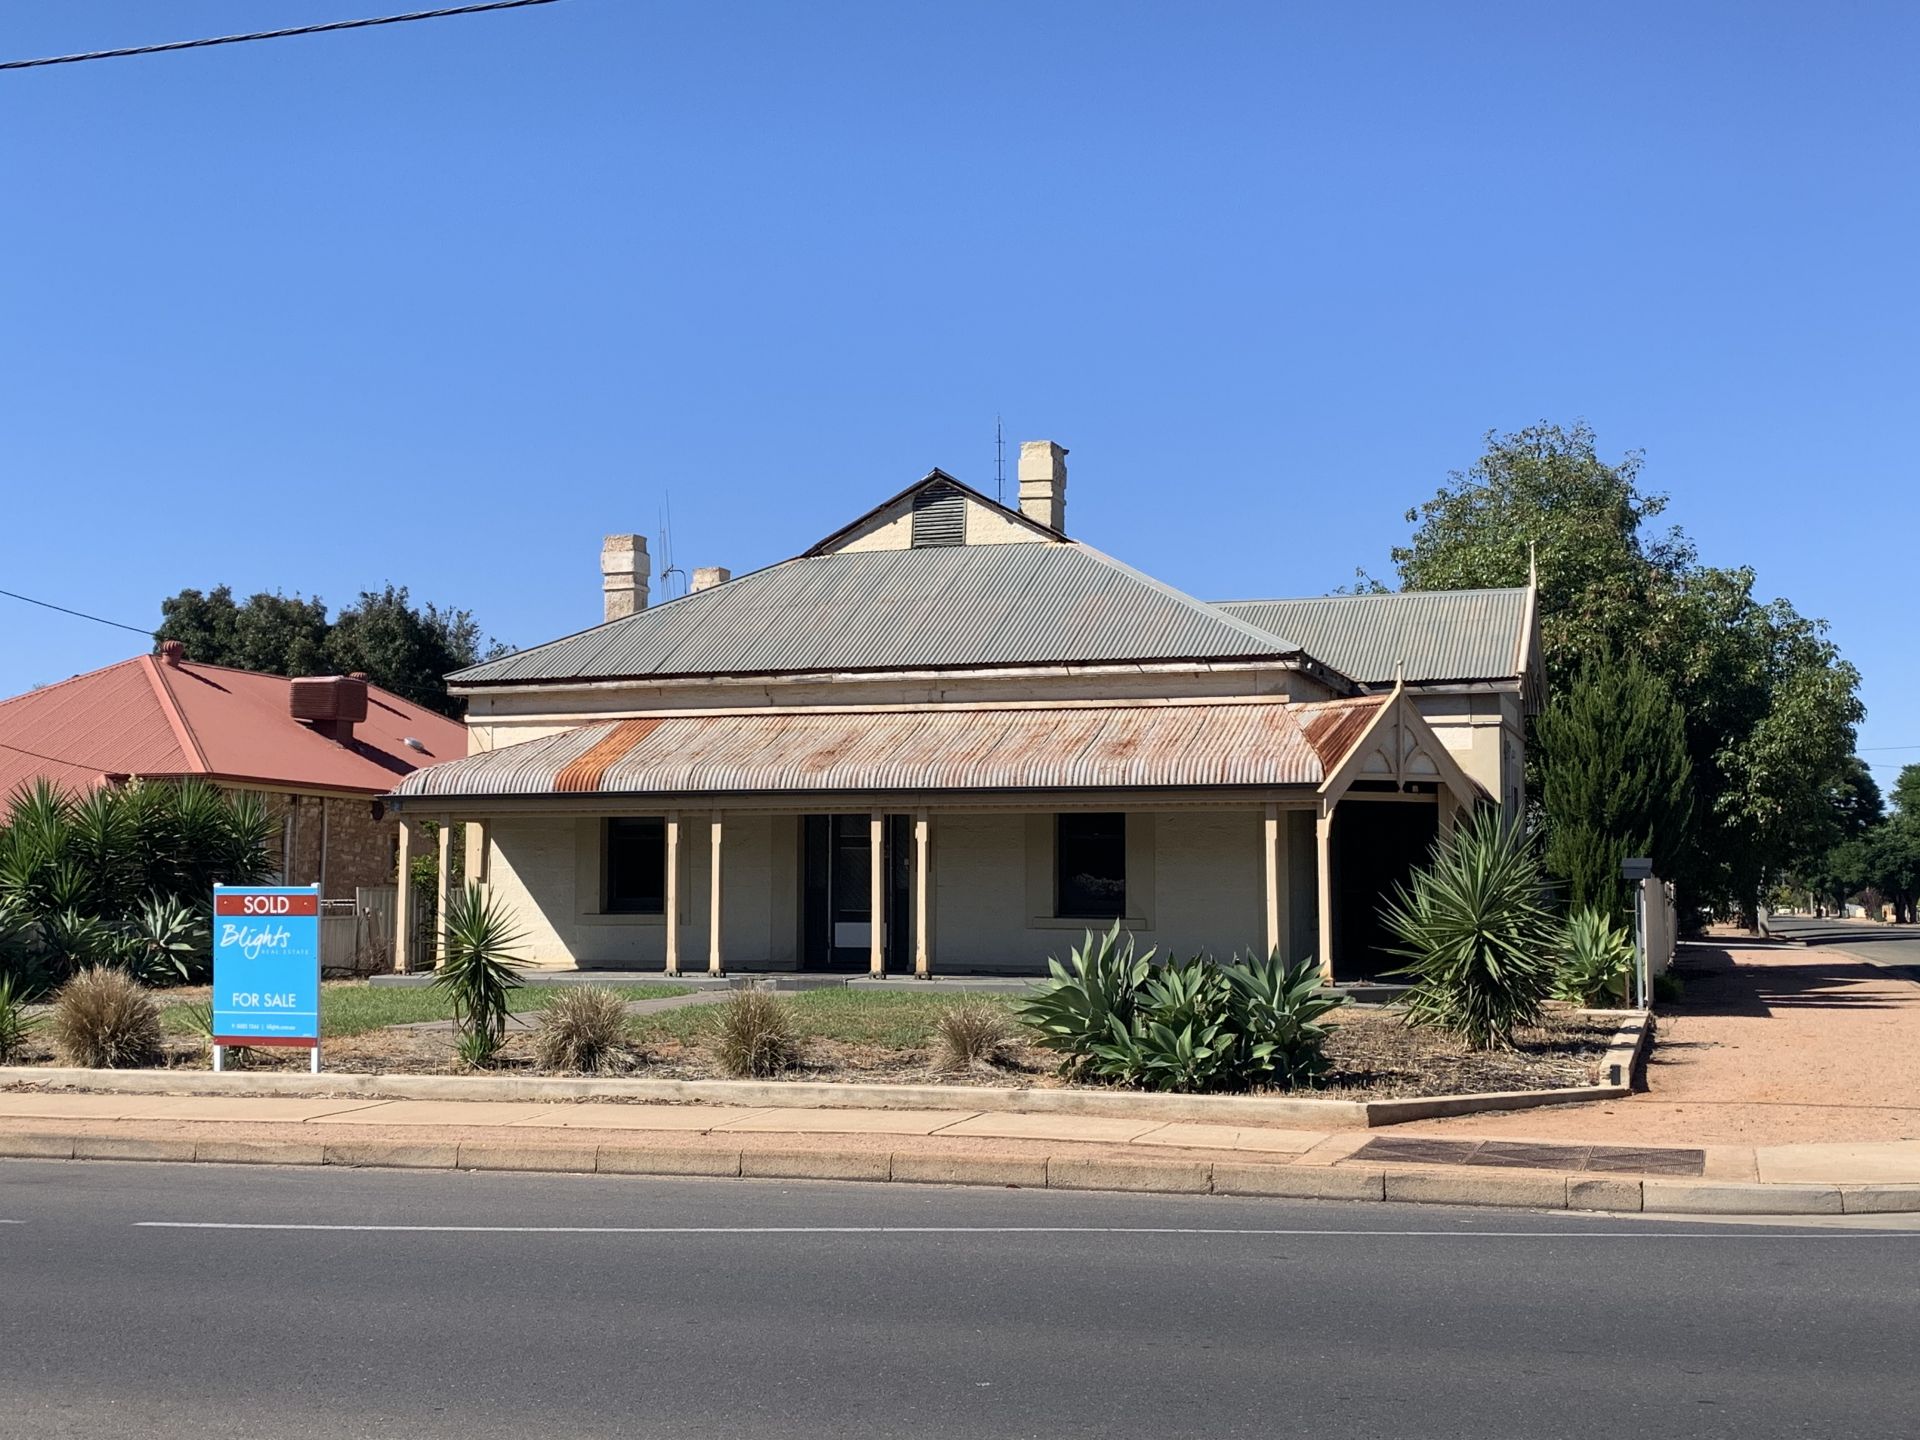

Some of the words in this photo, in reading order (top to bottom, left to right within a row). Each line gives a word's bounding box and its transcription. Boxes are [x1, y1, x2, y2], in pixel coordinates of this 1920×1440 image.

[244, 896, 289, 914] SOLD
[220, 924, 291, 960] Blights
[232, 992, 259, 1007] FOR
[263, 993, 296, 1008] SALE
